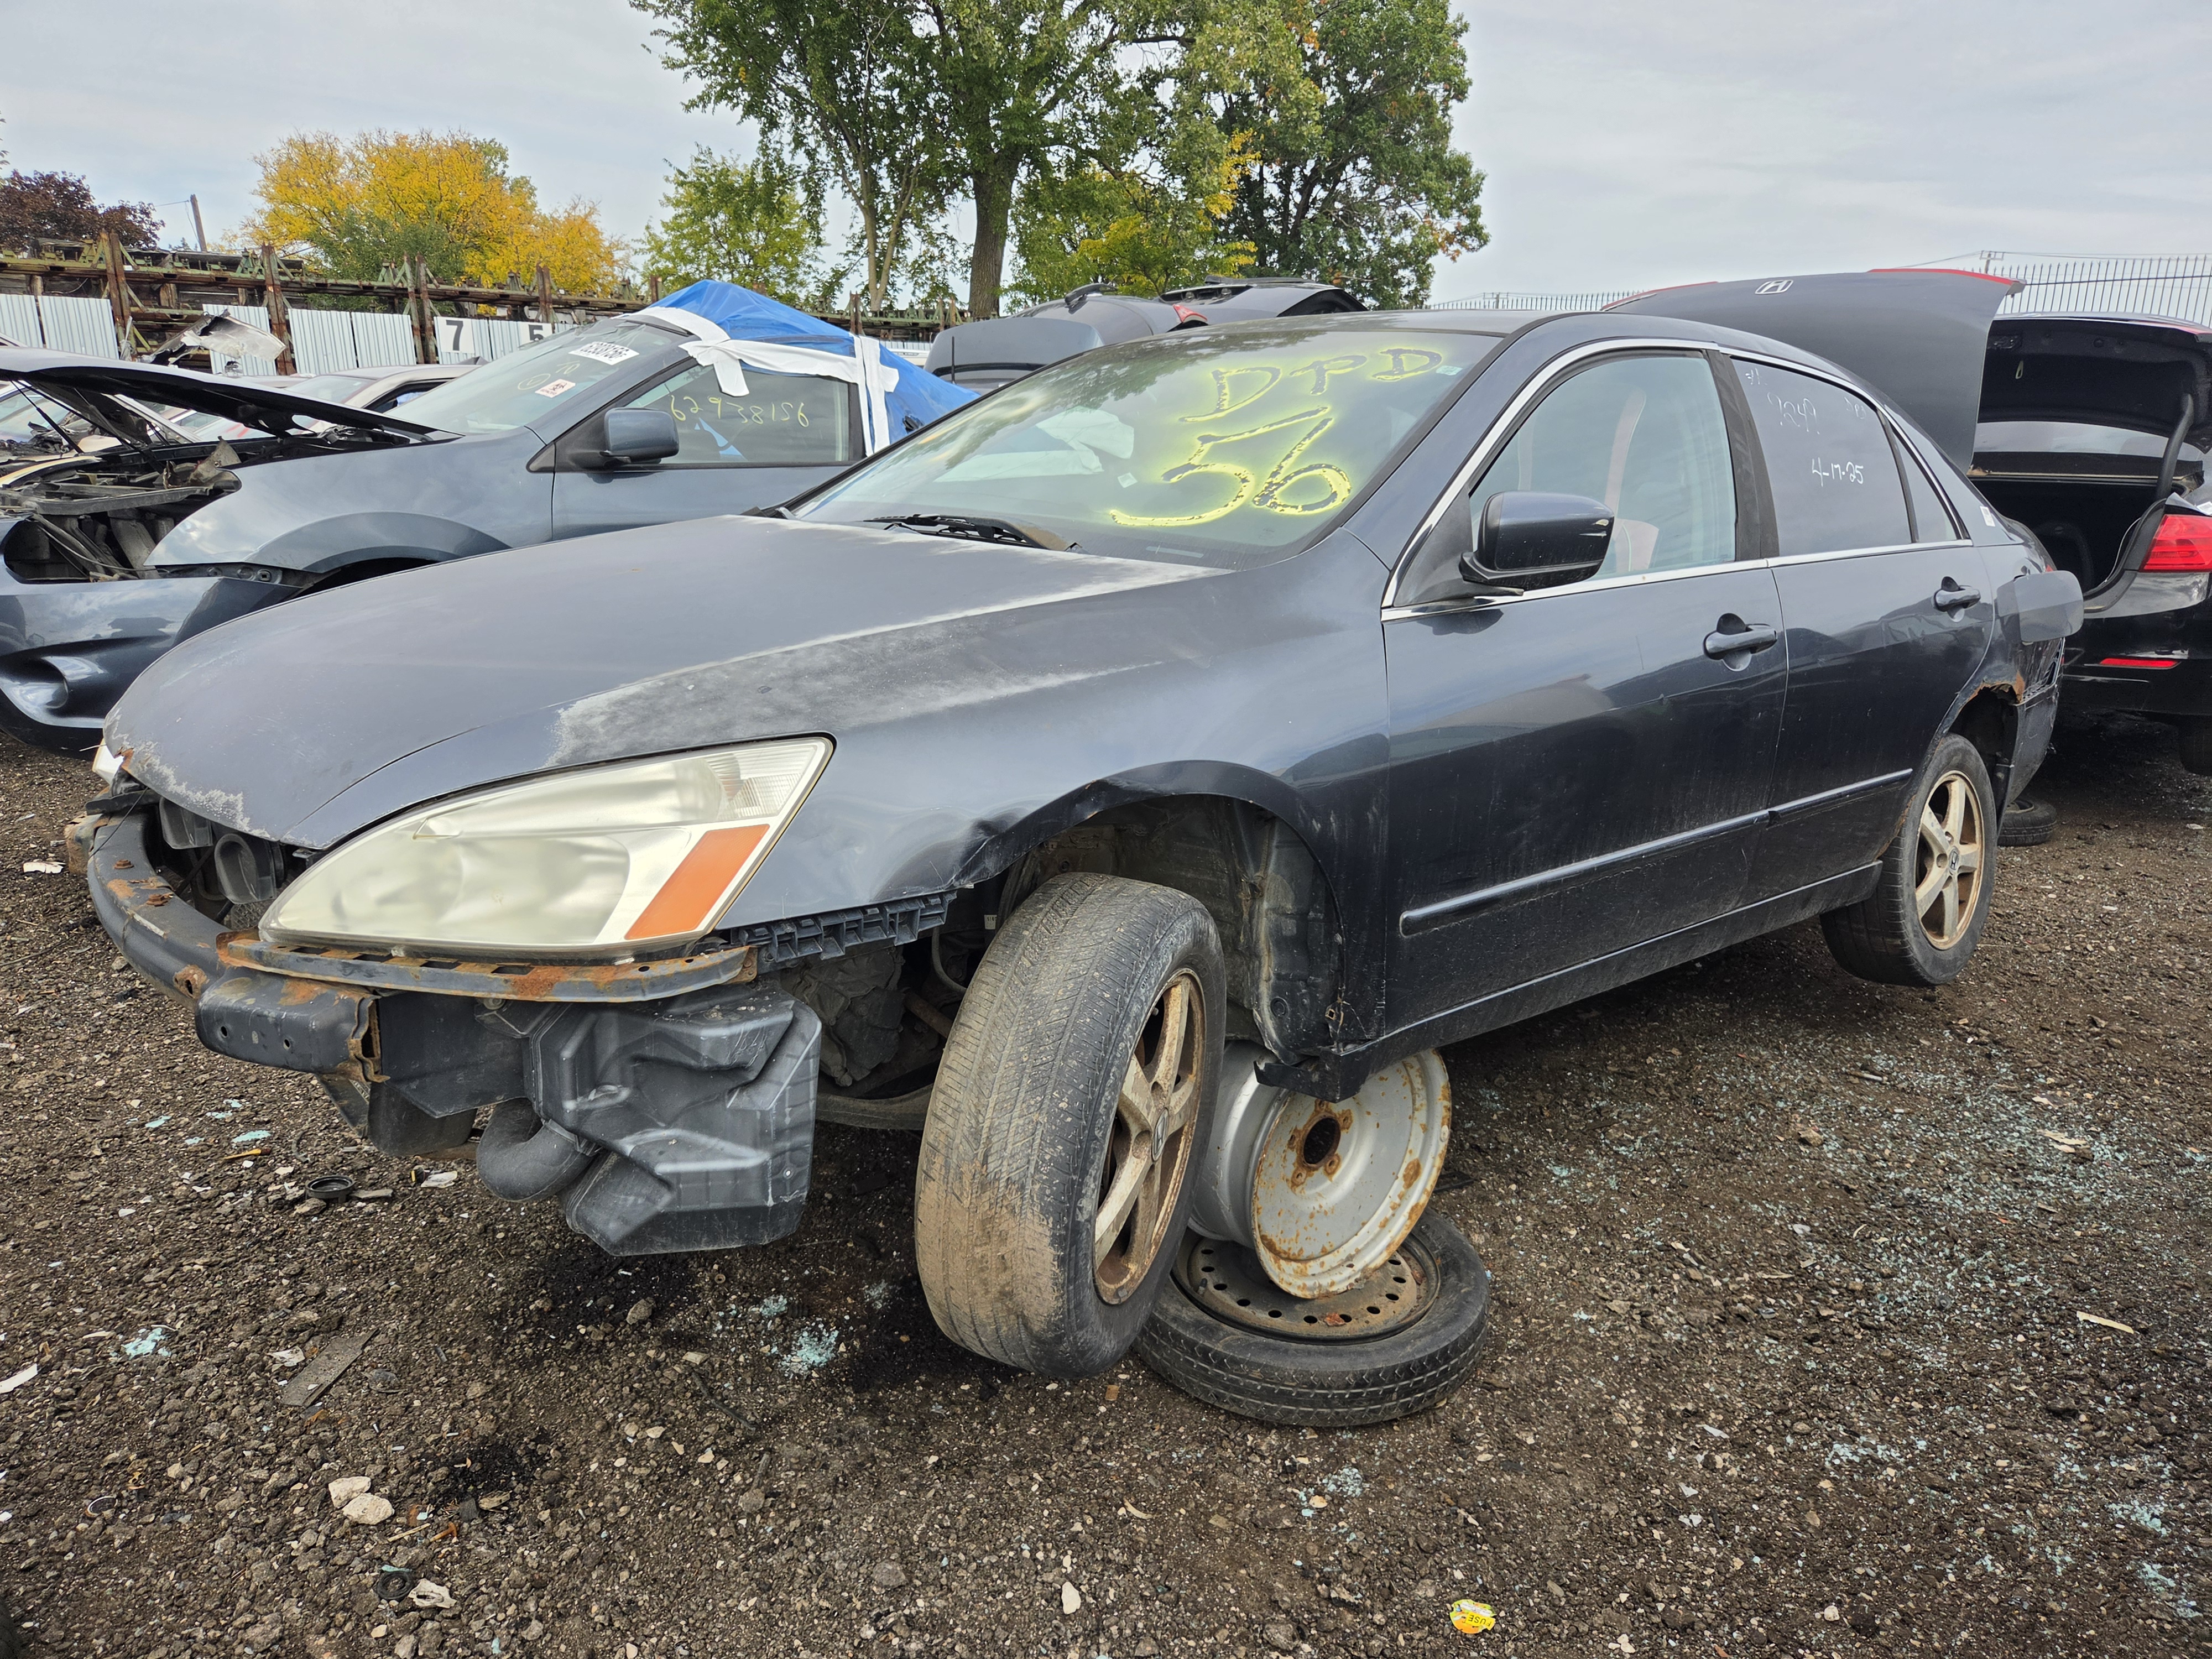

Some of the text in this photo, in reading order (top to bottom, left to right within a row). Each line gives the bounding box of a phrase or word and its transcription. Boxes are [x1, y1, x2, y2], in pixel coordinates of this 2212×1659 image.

[445, 319, 464, 351] 7
[1178, 347, 1443, 422] DPD
[670, 394, 810, 427] 62938156
[1109, 406, 1352, 527] 56
[1468, 1614, 1492, 1627] FUSE
